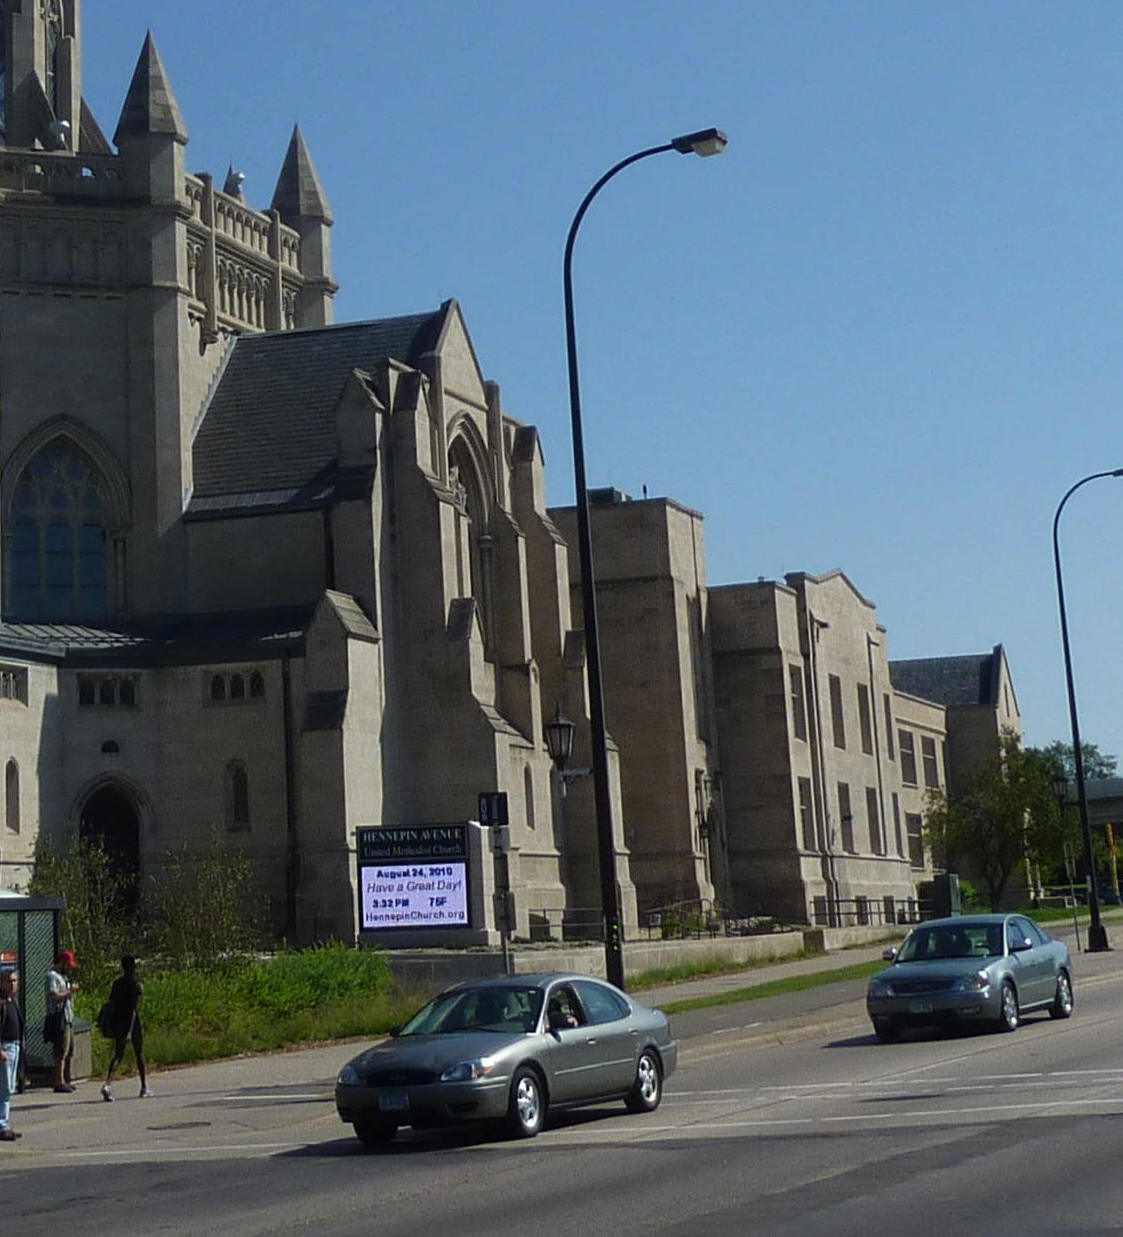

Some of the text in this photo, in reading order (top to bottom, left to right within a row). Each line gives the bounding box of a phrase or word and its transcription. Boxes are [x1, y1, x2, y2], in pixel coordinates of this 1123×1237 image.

[364, 828, 461, 842] HENNEPIN AVENUE
[376, 869, 410, 879] August
[429, 867, 453, 876] 2010
[367, 883, 394, 893] Have
[406, 881, 436, 891] Great
[437, 880, 461, 892] Day!
[395, 898, 409, 907] PM
[365, 910, 465, 922] HennepinChurch.org
